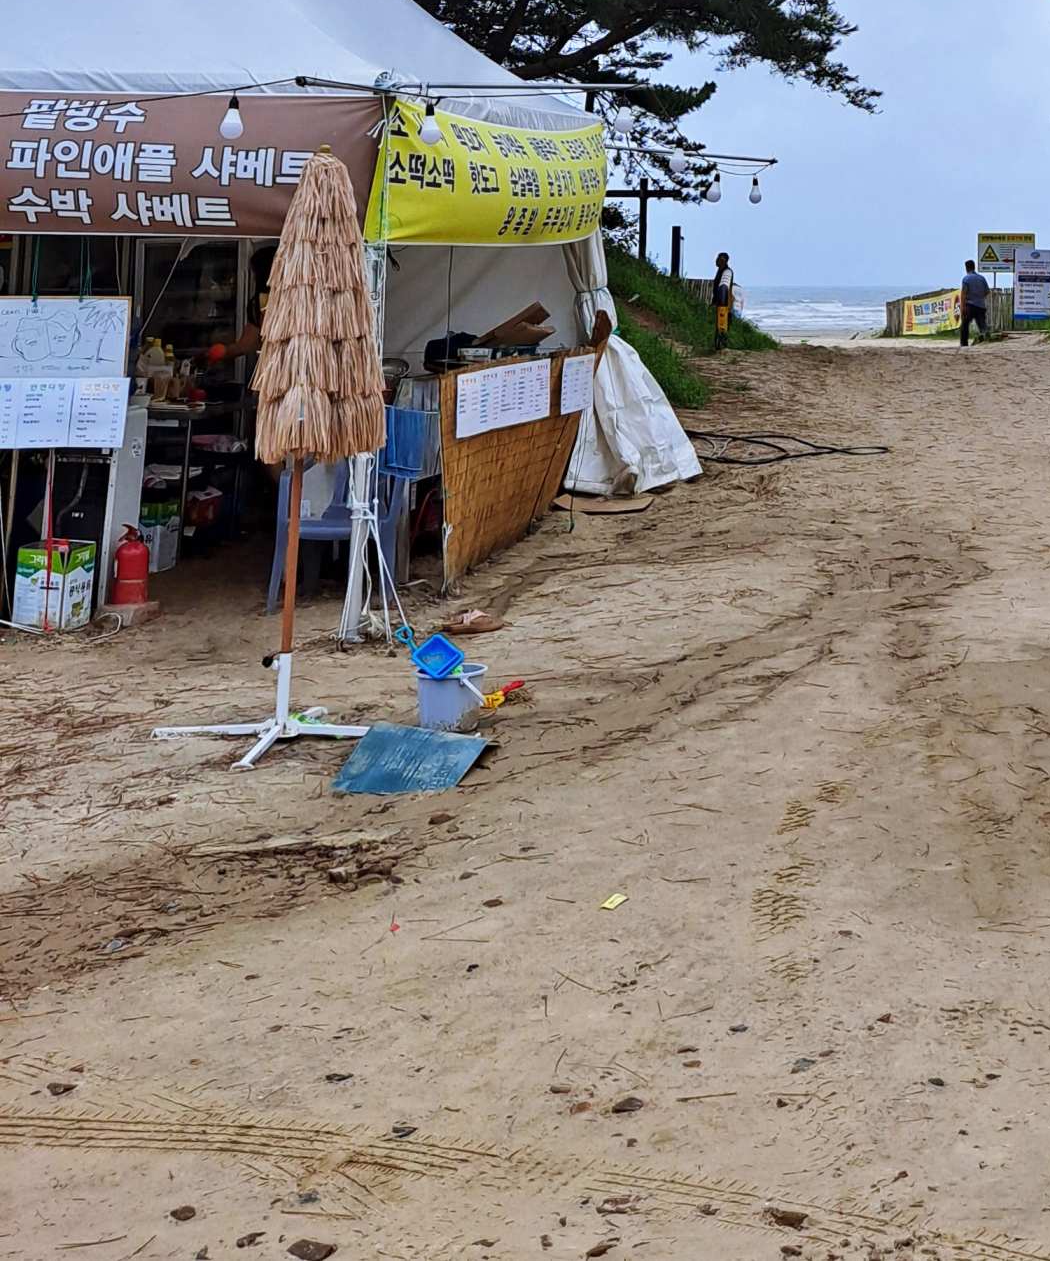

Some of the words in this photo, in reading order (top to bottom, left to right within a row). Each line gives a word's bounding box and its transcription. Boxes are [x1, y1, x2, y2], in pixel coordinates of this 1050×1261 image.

[22, 99, 147, 134] 팥빙수
[6, 138, 177, 183] 파인애플
[191, 145, 314, 188] 샤베트
[389, 150, 455, 193] 소떡소떡
[469, 160, 499, 194] 핫도그
[8, 186, 93, 224] 수박
[111, 192, 238, 228] 샤베트
